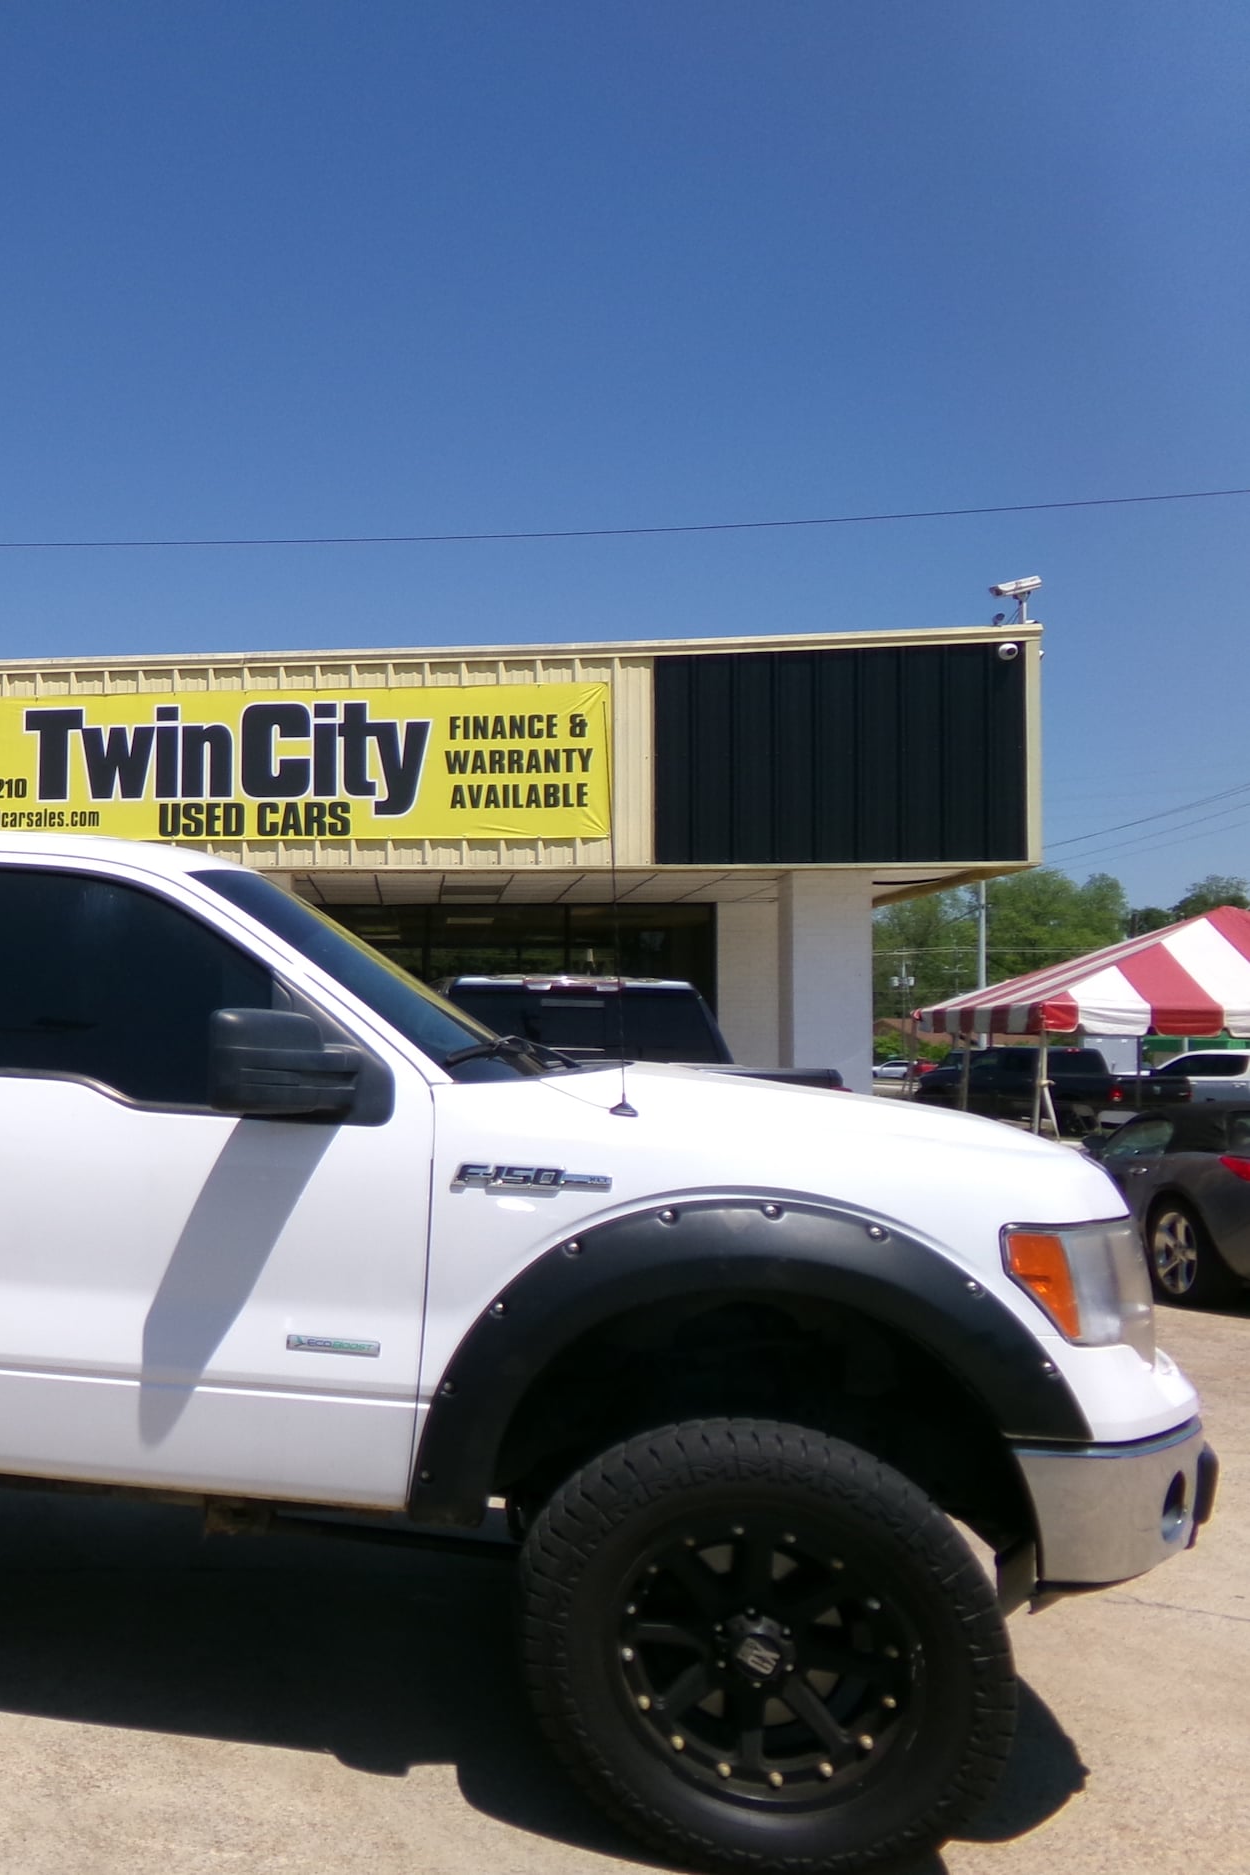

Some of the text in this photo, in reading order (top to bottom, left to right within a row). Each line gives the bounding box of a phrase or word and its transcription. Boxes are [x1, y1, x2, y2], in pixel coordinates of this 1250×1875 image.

[449, 713, 588, 740] FINANCE &
[445, 748, 593, 774] WARRANTY
[450, 783, 588, 808] AVAILABLE
[159, 801, 350, 837] USED CARS
